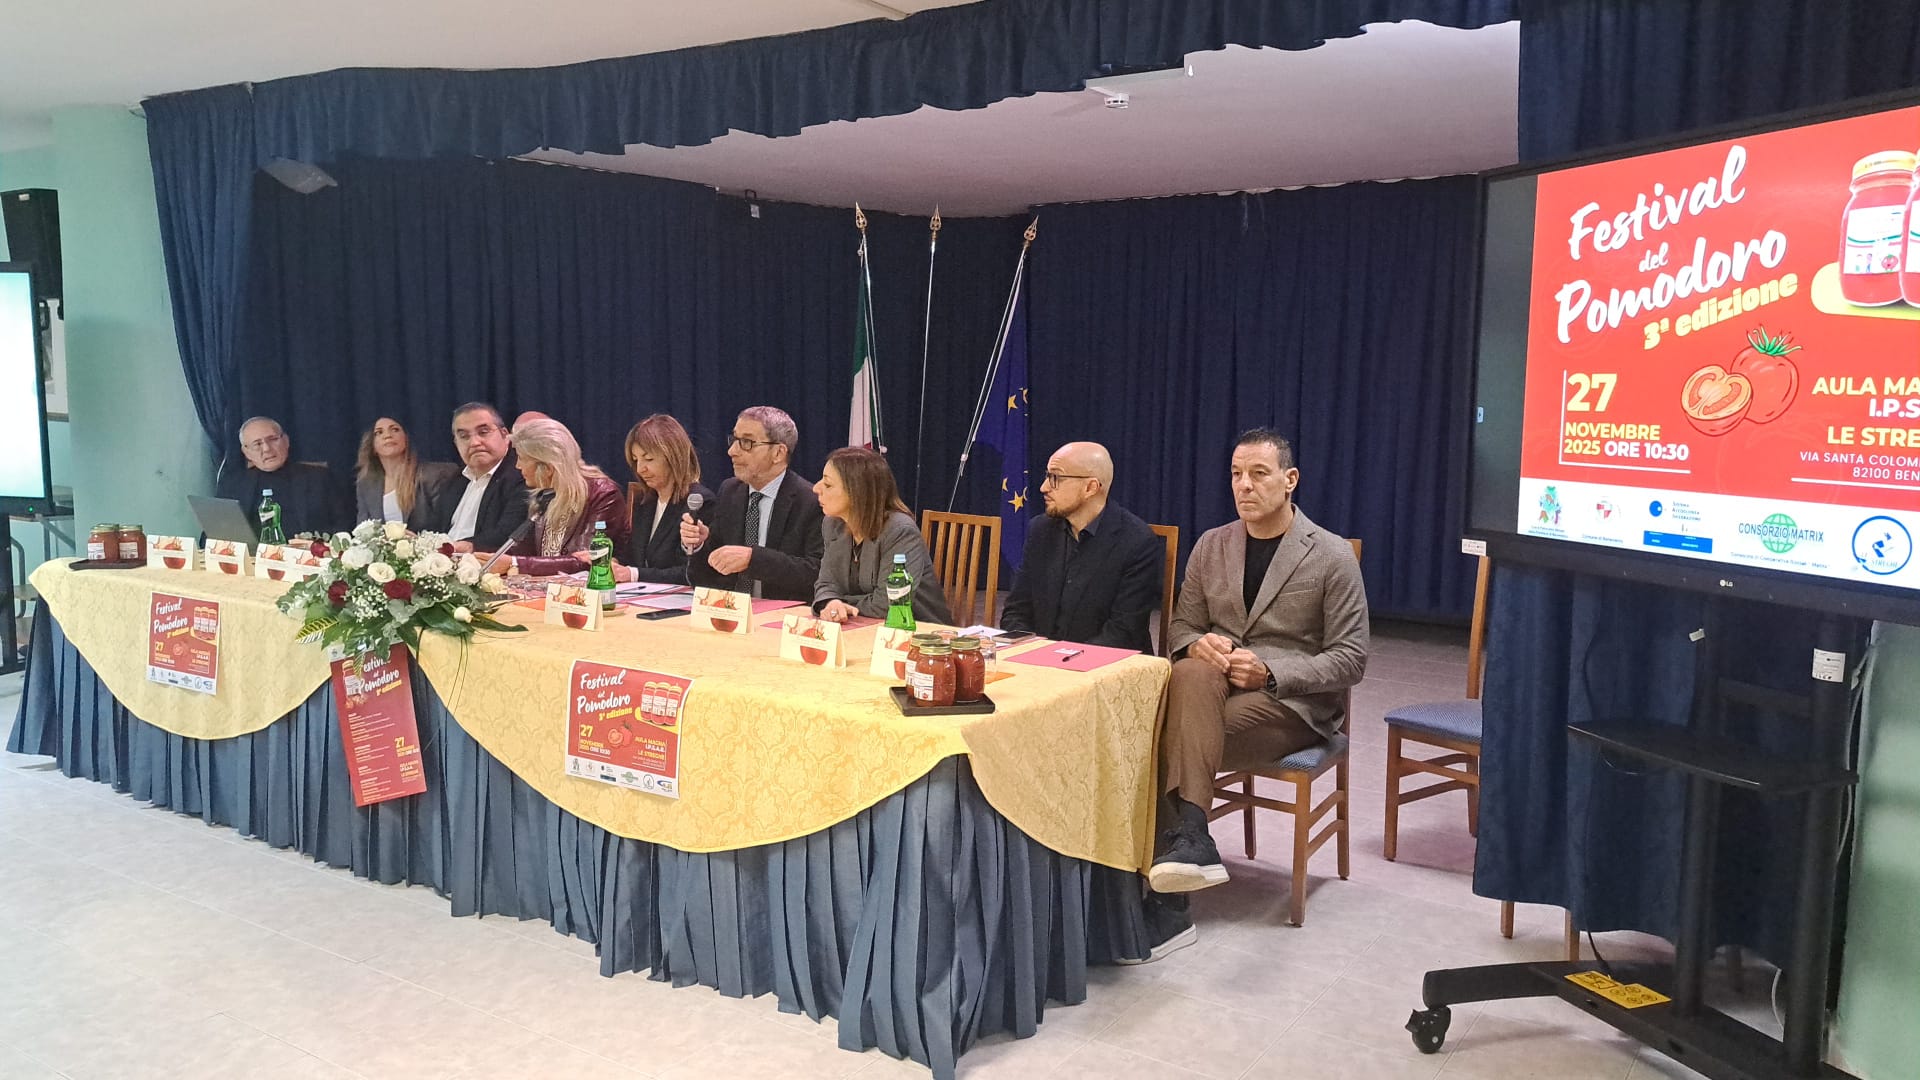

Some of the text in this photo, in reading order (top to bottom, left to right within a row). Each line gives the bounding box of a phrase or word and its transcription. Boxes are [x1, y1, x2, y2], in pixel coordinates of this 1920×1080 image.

[1568, 145, 1747, 260] Festival
[1638, 242, 1669, 272] del
[1555, 230, 1787, 343] Pomodoro
[1675, 273, 1798, 336] edizione
[1567, 373, 1618, 412] 27
[1812, 377, 1877, 395] AULA
[1565, 422, 1660, 440] NOVEMBRE
[1827, 426, 1920, 447] LE STRE
[1564, 439, 1689, 461] 2025 ORE 10:30
[1800, 451, 1920, 467] VIA SANTA COLOM
[1853, 467, 1890, 479] 82100
[155, 598, 182, 615] Festival
[153, 616, 188, 634] Pomodoro
[358, 669, 400, 694] Pomodoro
[580, 669, 627, 690] Festival
[577, 692, 631, 714] Pomodoro
[606, 707, 633, 719] edizione
[580, 724, 594, 738] 27
